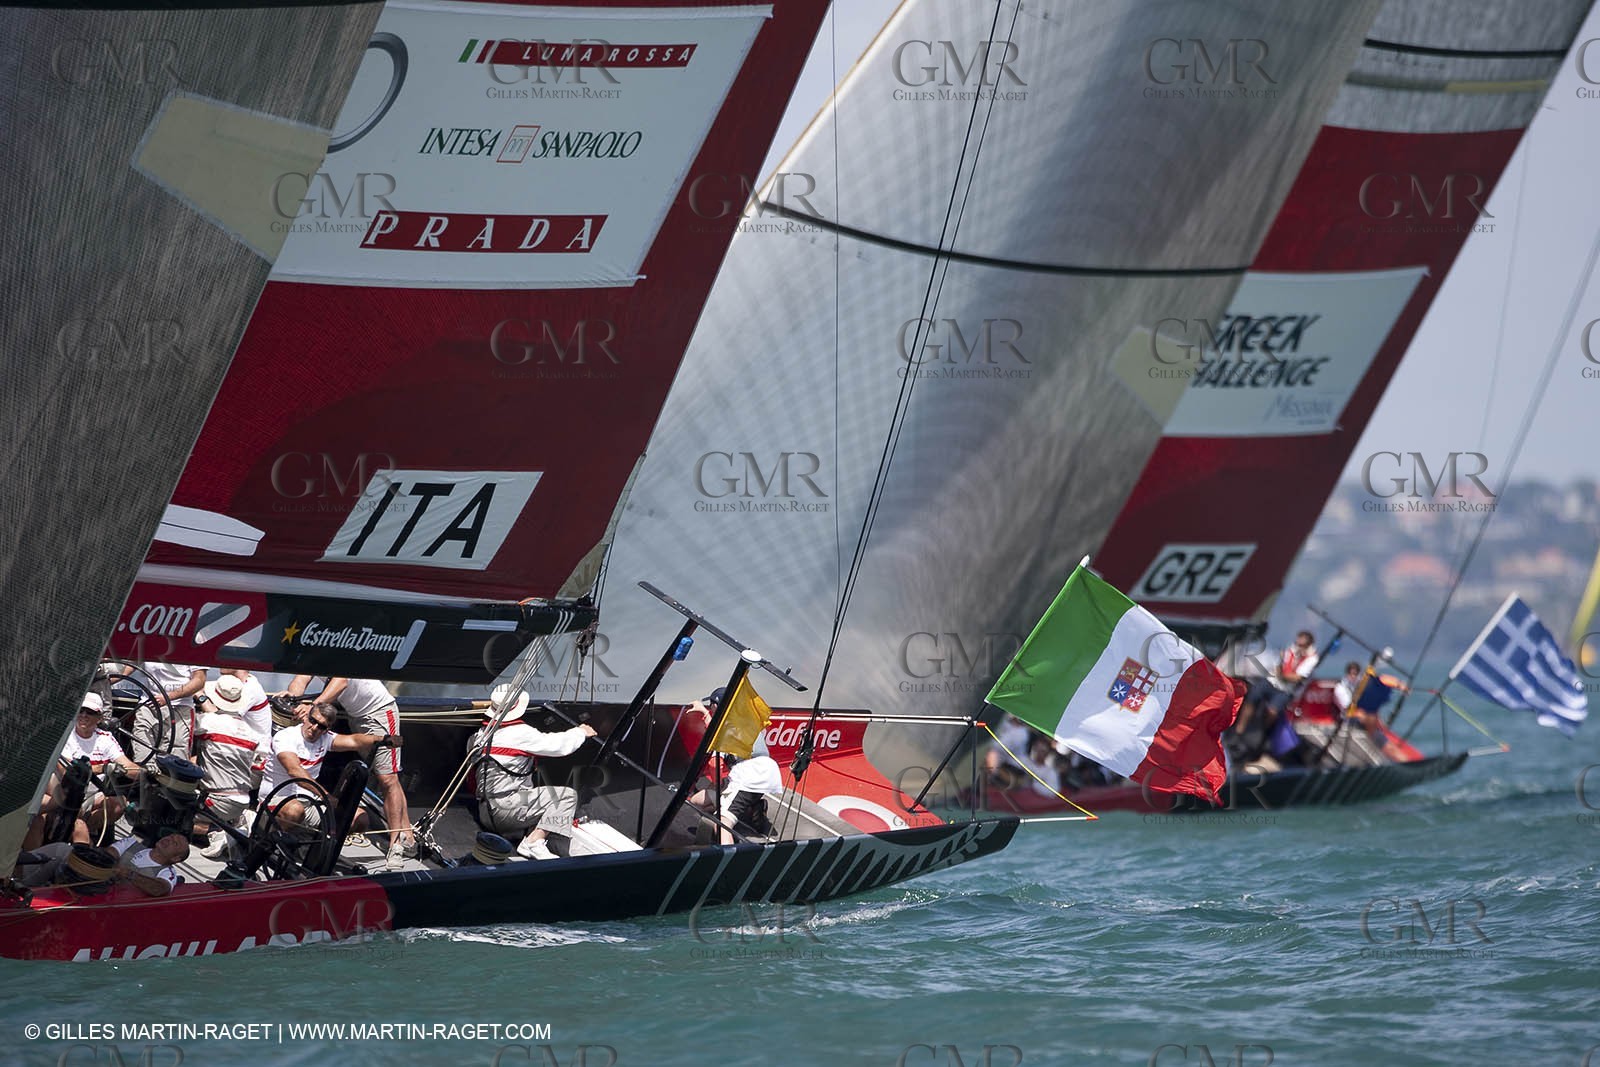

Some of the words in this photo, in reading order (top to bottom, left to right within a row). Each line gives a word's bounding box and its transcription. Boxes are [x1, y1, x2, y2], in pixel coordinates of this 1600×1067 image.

[522, 46, 591, 62] LUNA
[608, 47, 691, 62] ROSSA
[418, 127, 502, 157] INTESA
[532, 131, 643, 159] SANPAOLO
[364, 213, 593, 249] PRADA
[346, 482, 497, 559] ITA
[1142, 551, 1246, 596] GRE
[118, 603, 194, 637] .com
